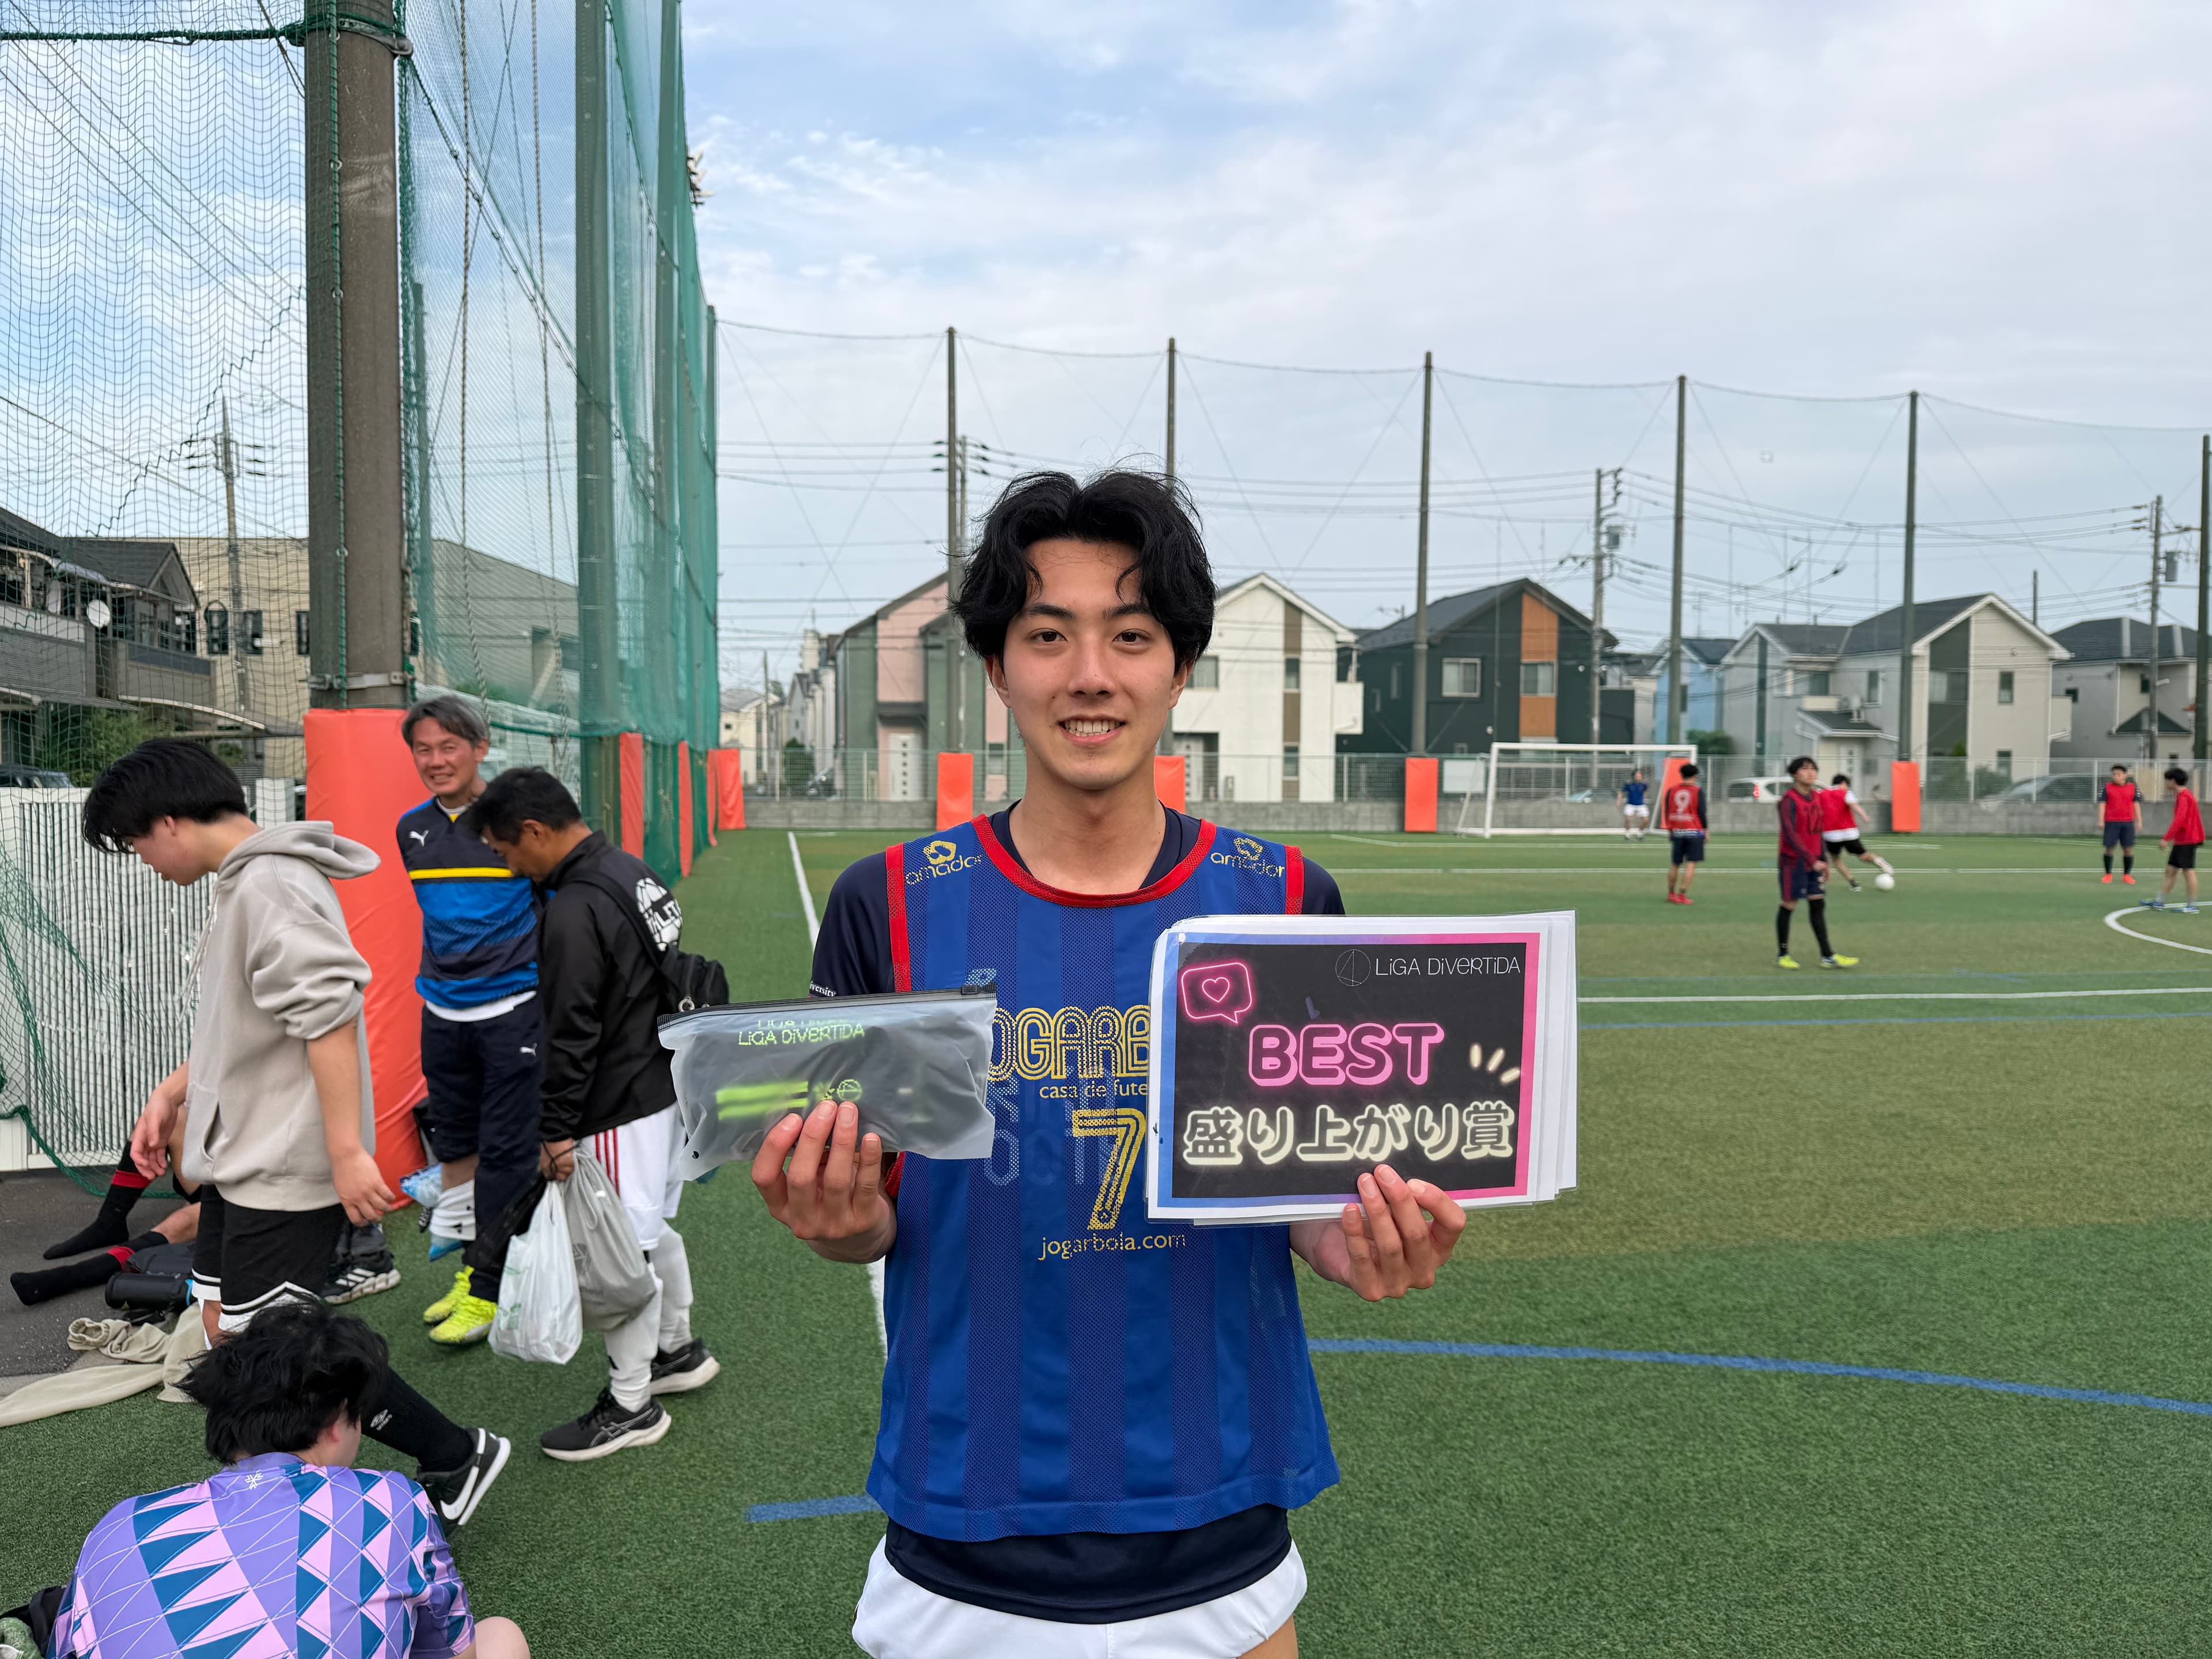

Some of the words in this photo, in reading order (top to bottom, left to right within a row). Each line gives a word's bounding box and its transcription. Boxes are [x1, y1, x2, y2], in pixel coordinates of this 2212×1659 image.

[1674, 789, 1690, 813] 9
[1210, 852, 1285, 877] amador
[1248, 1022, 1445, 1086] BEST
[1039, 1085, 1078, 1099] casa
[1085, 1081, 1107, 1097] de
[1183, 1101, 1515, 1165] 盛り上がり賞
[1072, 1108, 1146, 1230] 7
